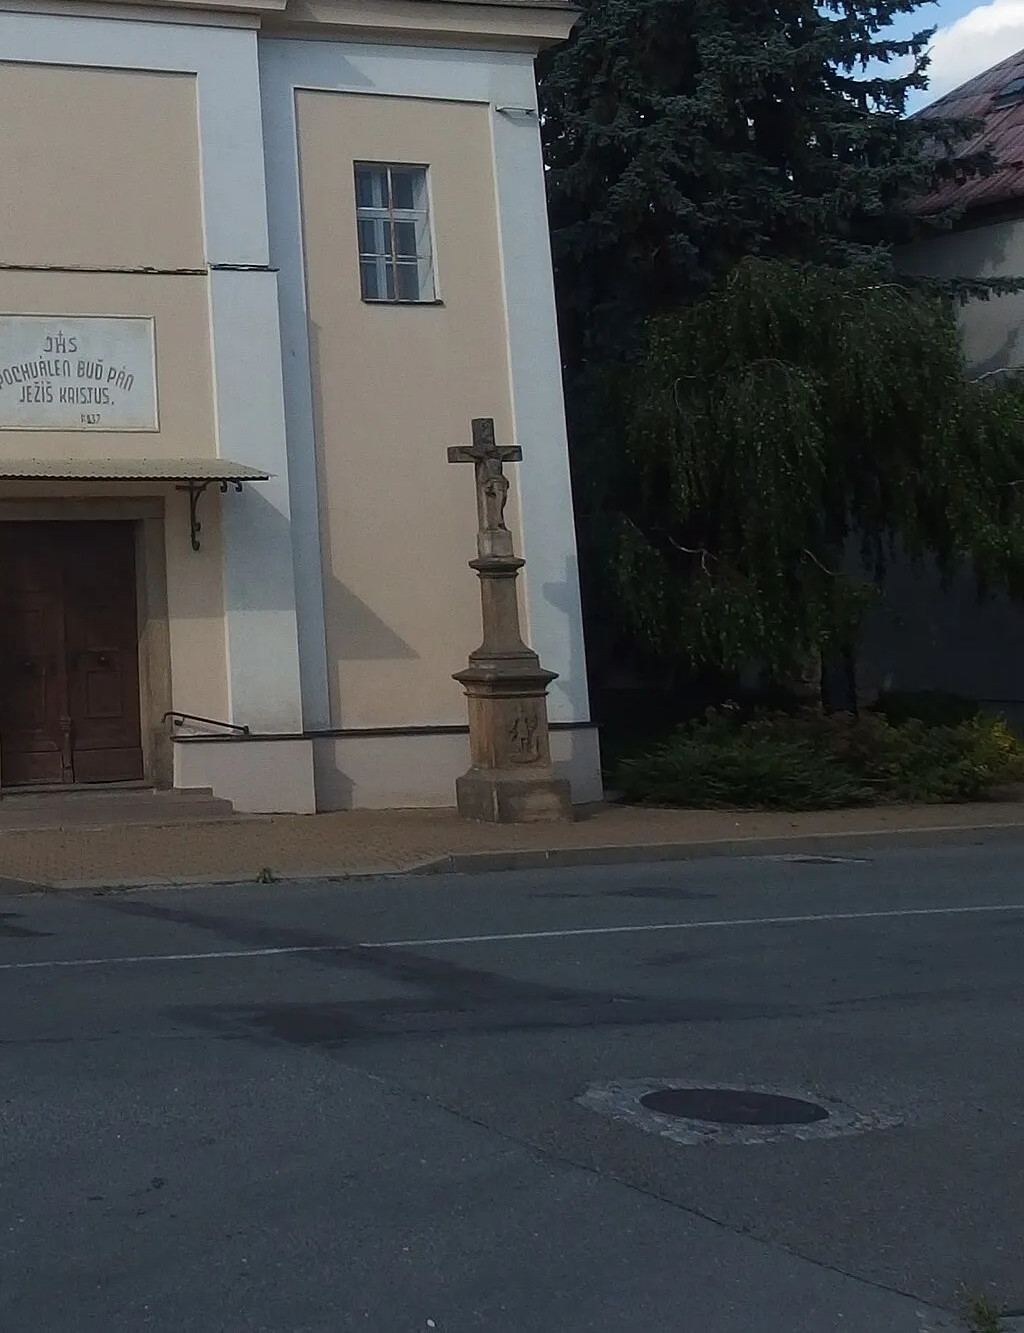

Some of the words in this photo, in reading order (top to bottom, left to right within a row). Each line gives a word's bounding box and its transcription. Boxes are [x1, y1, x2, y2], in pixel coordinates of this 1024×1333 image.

[77, 358, 103, 381] BUĎ
[106, 365, 134, 391] PÁN
[19, 380, 54, 403] JEŽÍŠ
